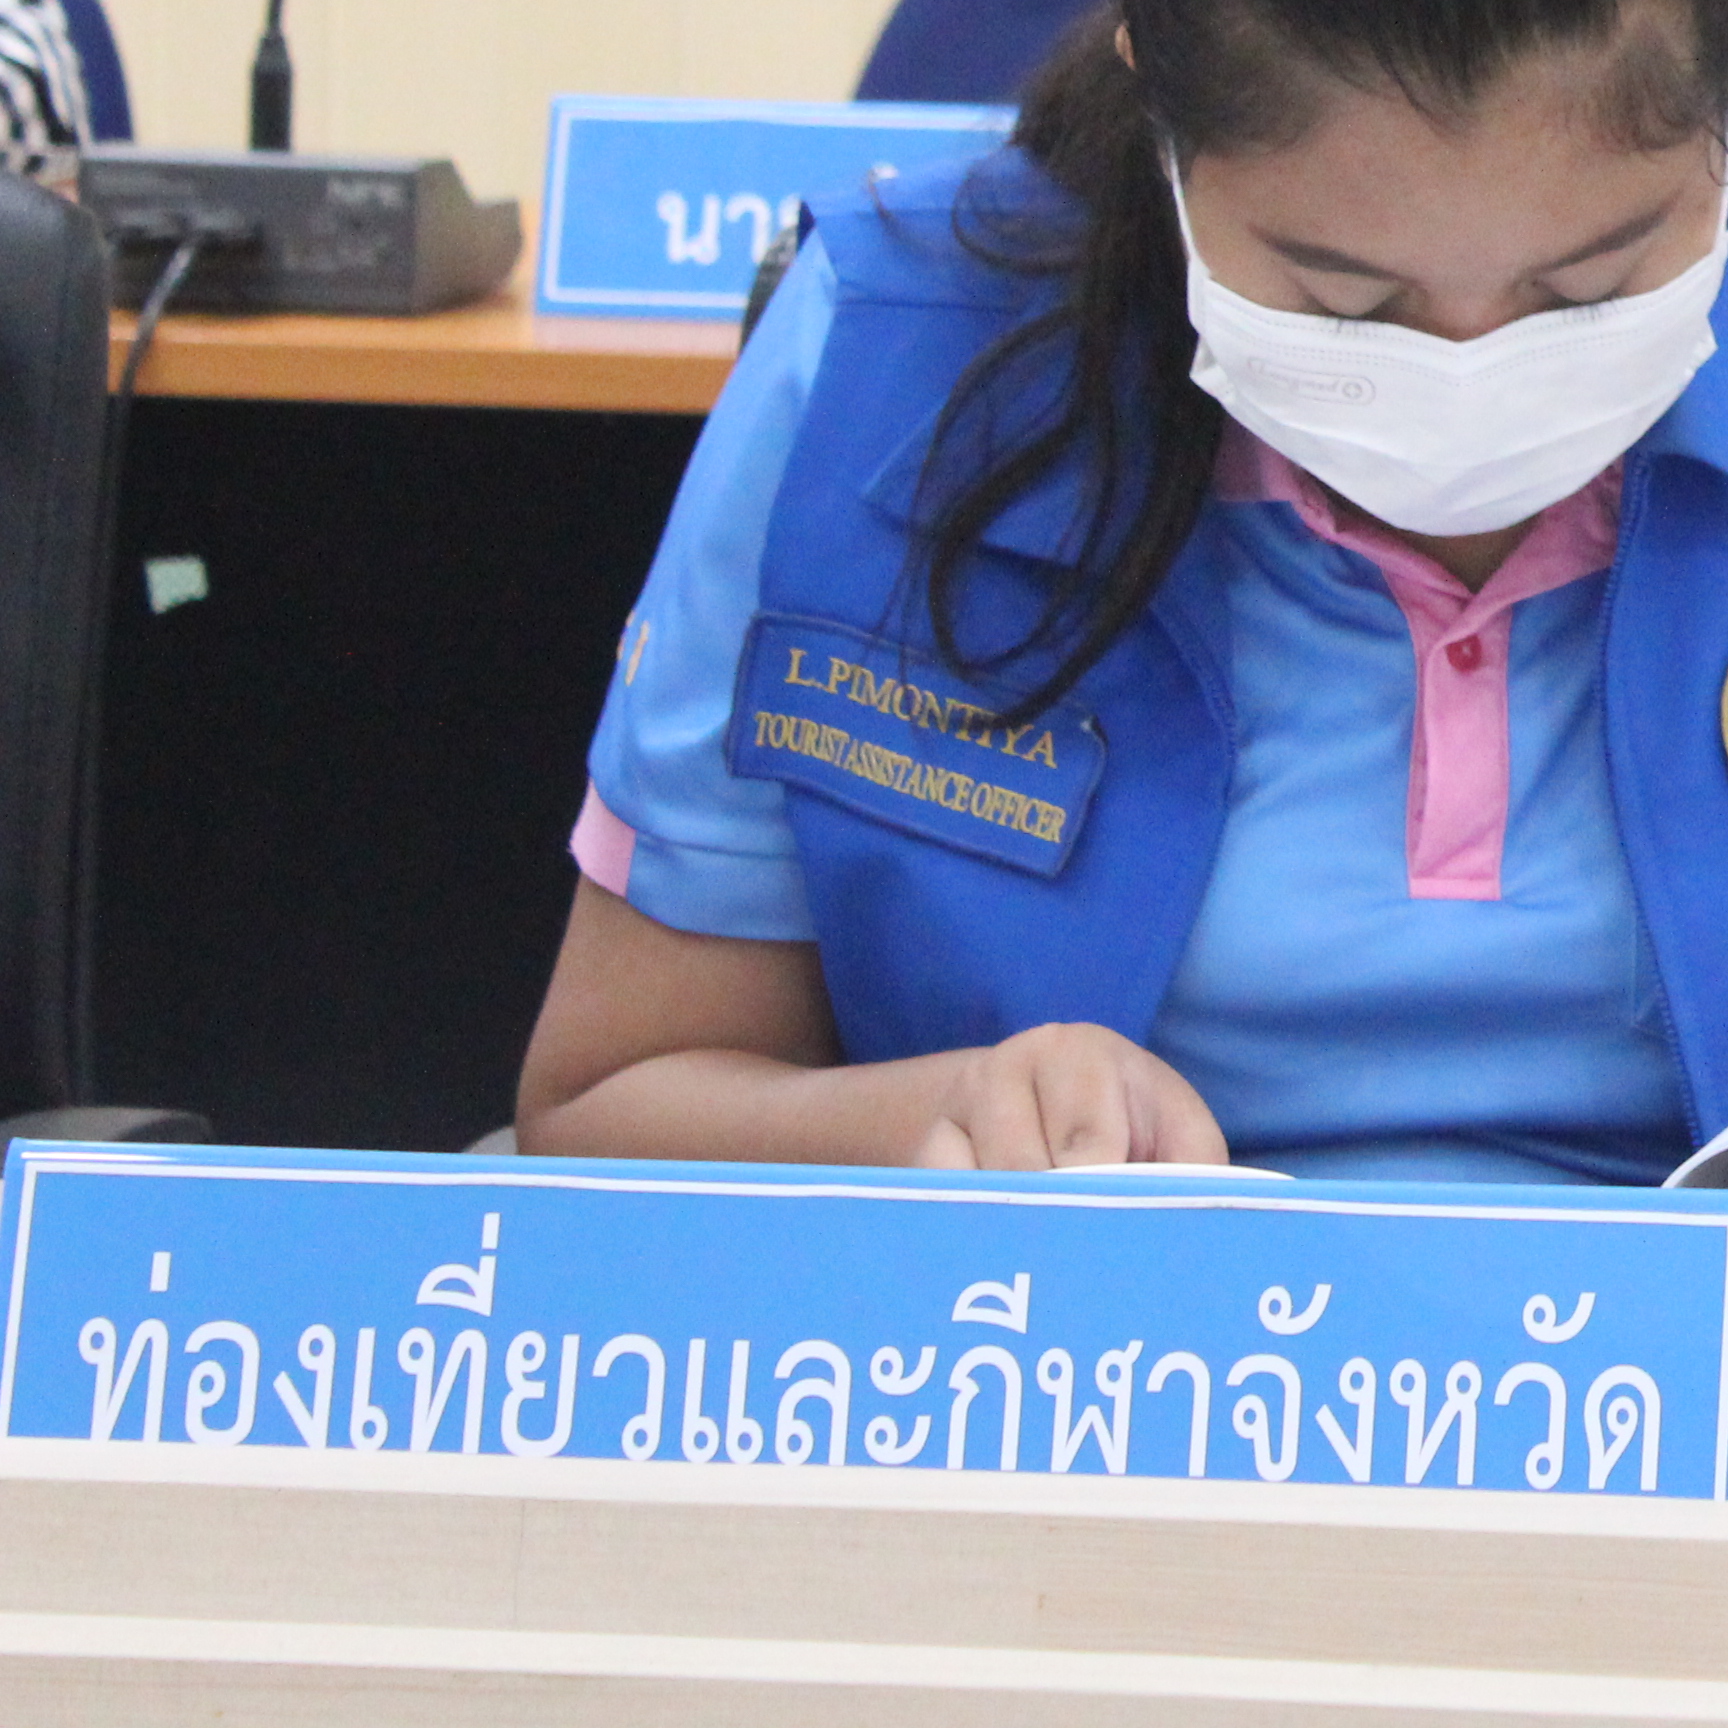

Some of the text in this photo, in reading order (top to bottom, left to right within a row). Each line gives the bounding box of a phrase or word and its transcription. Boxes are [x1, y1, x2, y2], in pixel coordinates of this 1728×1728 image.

[754, 710, 1067, 843] TOURIST ASSISTANCE OFFICER
[78, 1212, 1664, 1494] ท่องเที่ยวและกีฬาจังหวัด
